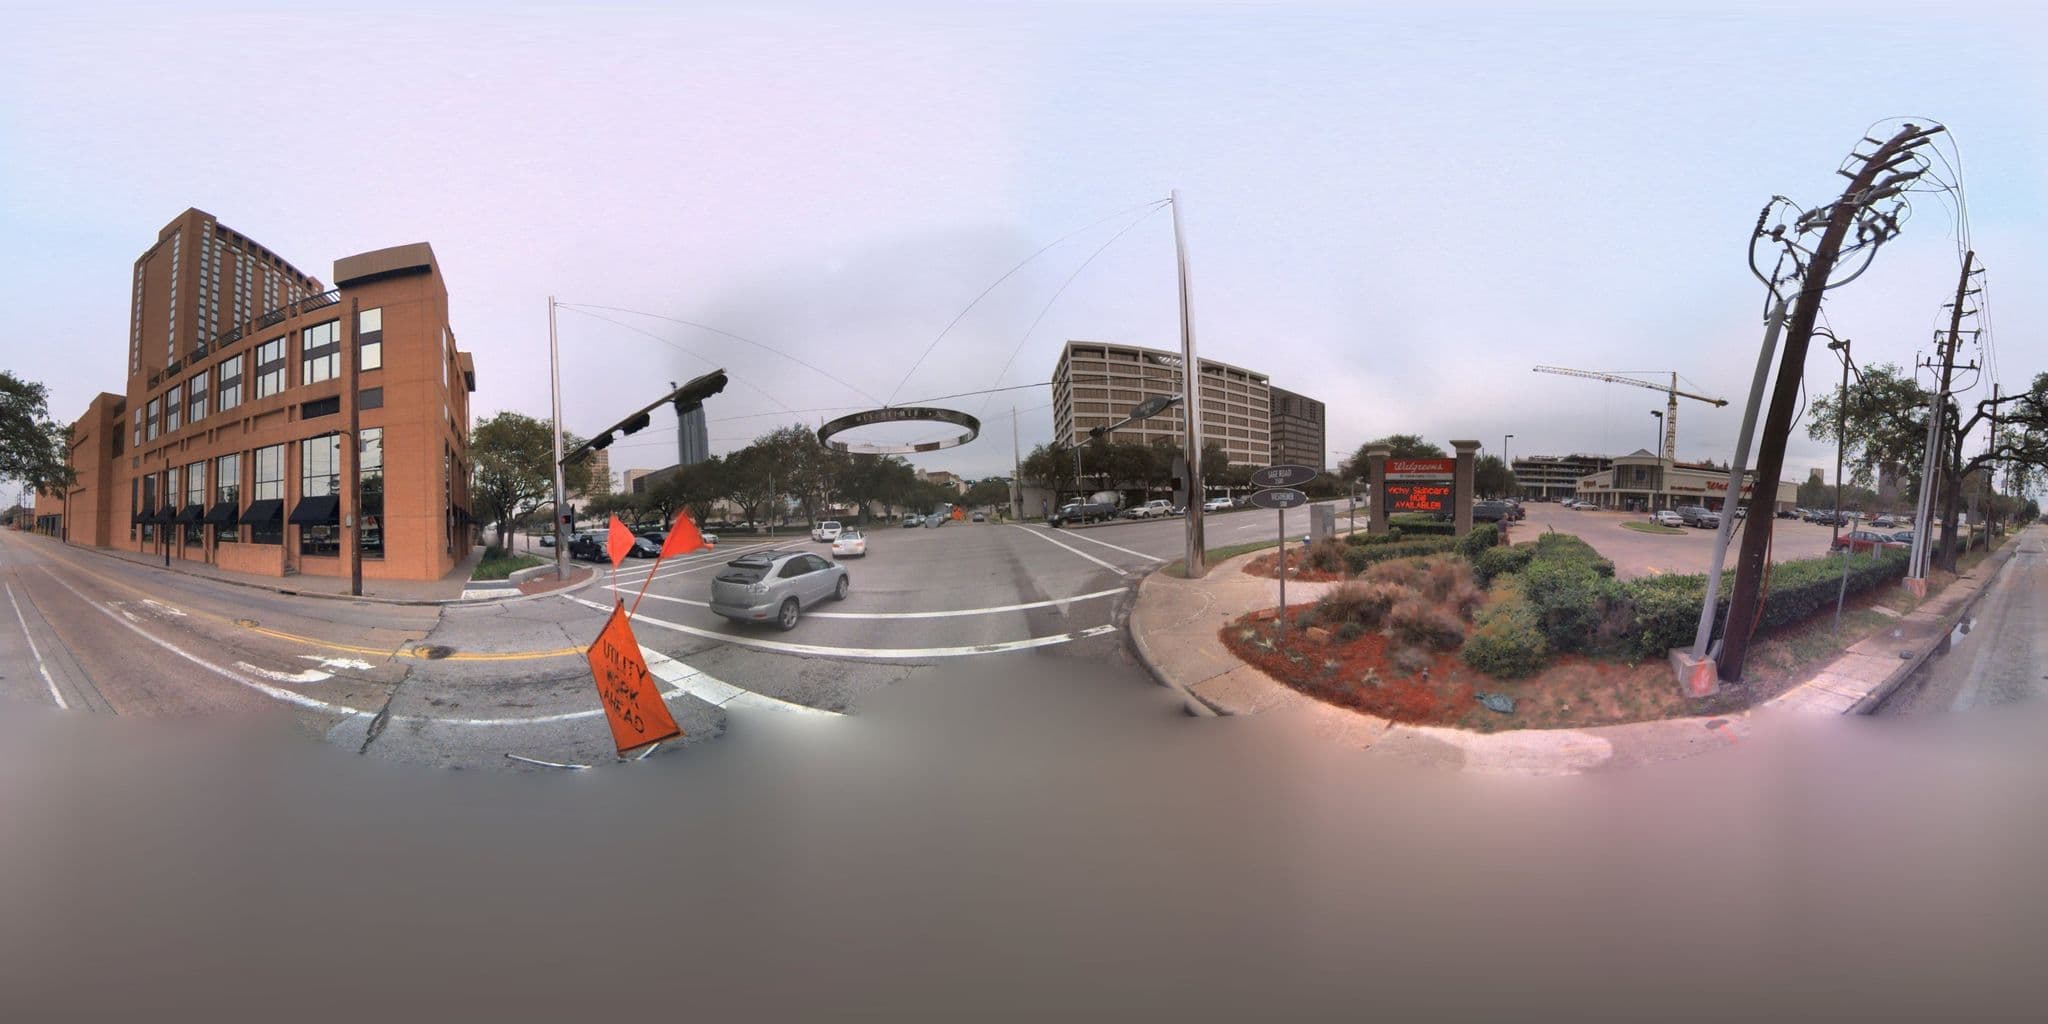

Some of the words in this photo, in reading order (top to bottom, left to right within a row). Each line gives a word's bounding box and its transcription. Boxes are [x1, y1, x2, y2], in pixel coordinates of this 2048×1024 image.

[1393, 461, 1443, 473] Walgreens
[603, 639, 646, 686] UTILITY
[603, 688, 645, 734] AHEAD
[607, 670, 639, 711] WORK
